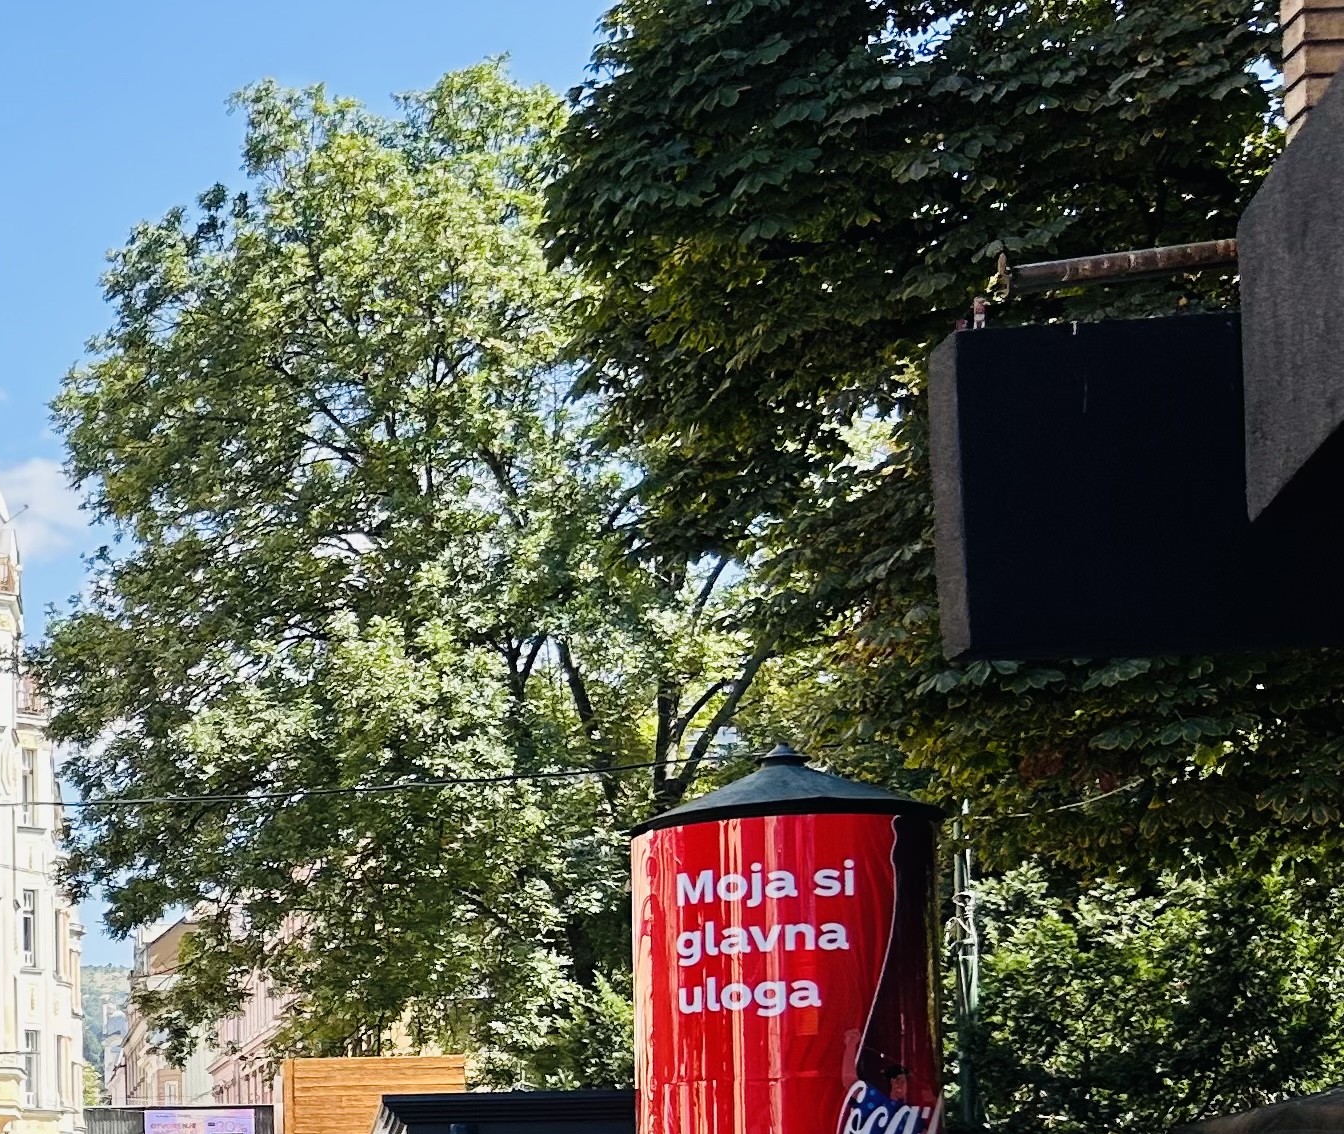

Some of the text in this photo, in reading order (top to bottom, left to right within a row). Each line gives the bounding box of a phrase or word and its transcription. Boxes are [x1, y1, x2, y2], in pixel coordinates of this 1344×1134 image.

[676, 859, 855, 909] Moja si
[676, 920, 850, 967] glavna
[678, 976, 822, 1018] uloga
